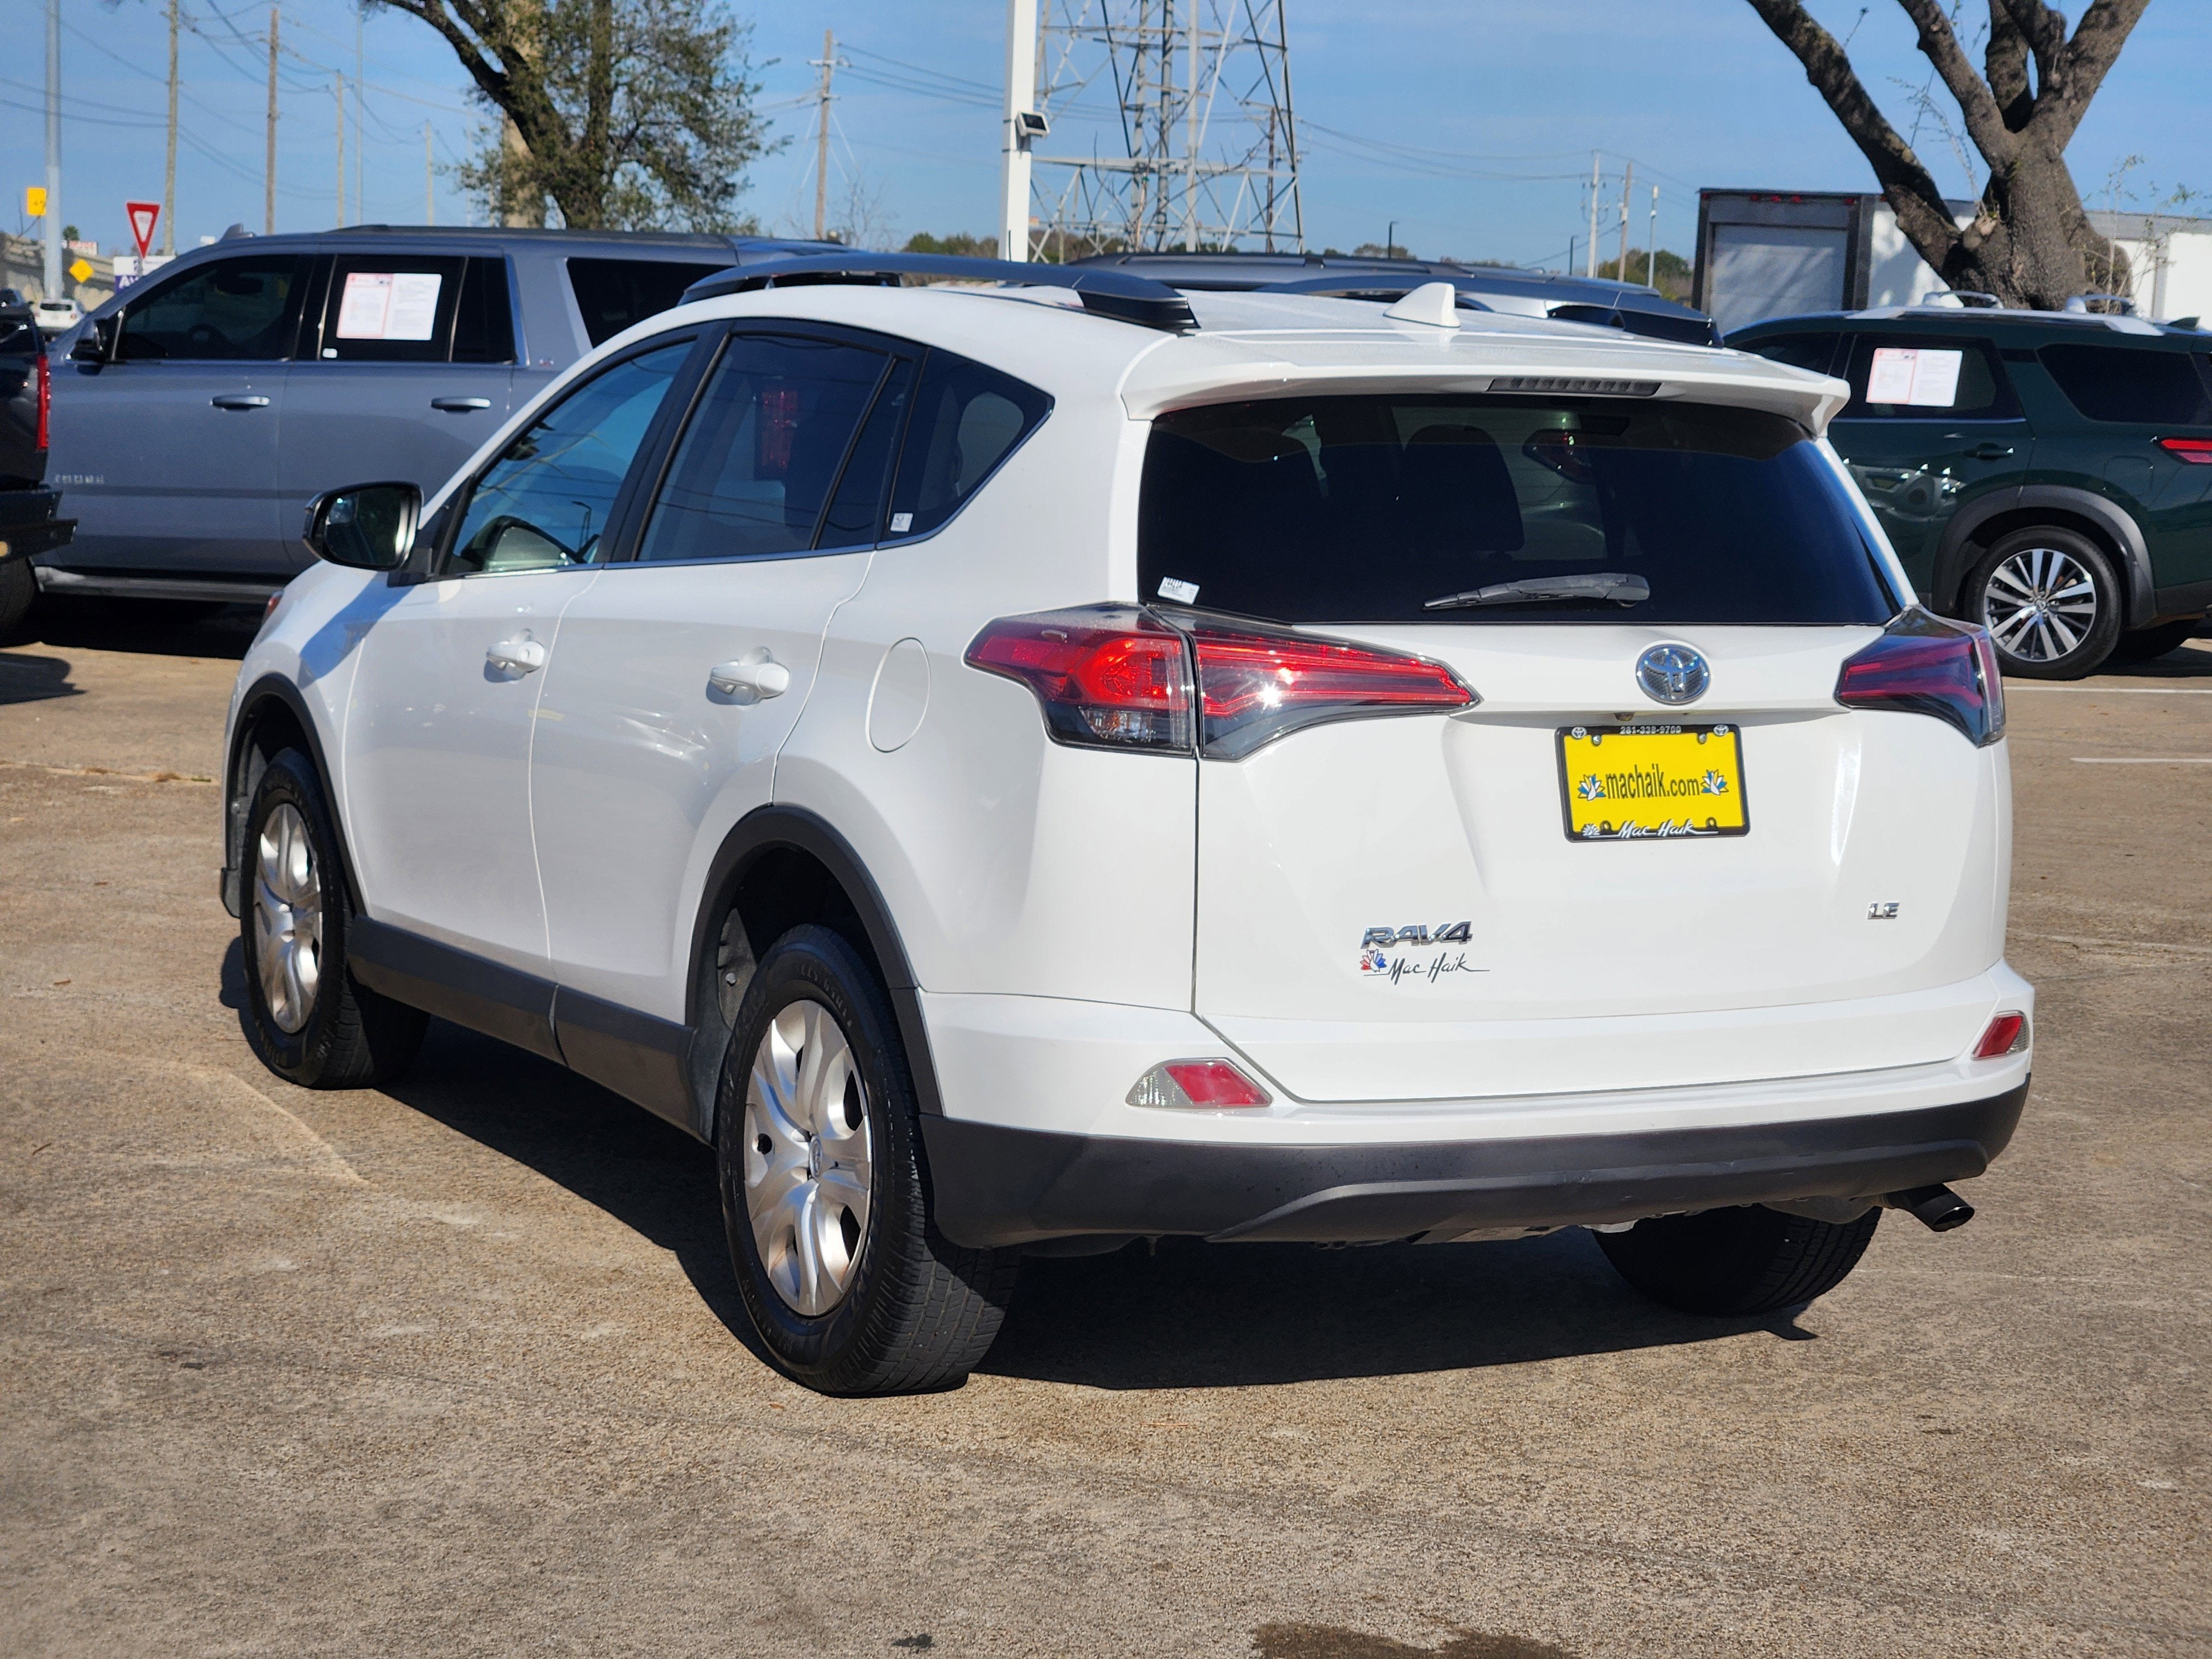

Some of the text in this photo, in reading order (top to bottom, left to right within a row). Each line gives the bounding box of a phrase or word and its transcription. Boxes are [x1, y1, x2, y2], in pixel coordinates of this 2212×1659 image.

[1605, 763, 1700, 799] machaik.com
[1609, 818, 1706, 838] Mac Haik
[1867, 902, 1900, 920] LE
[1360, 921, 1473, 949] RAV4
[1383, 952, 1480, 985] Mac Haik
